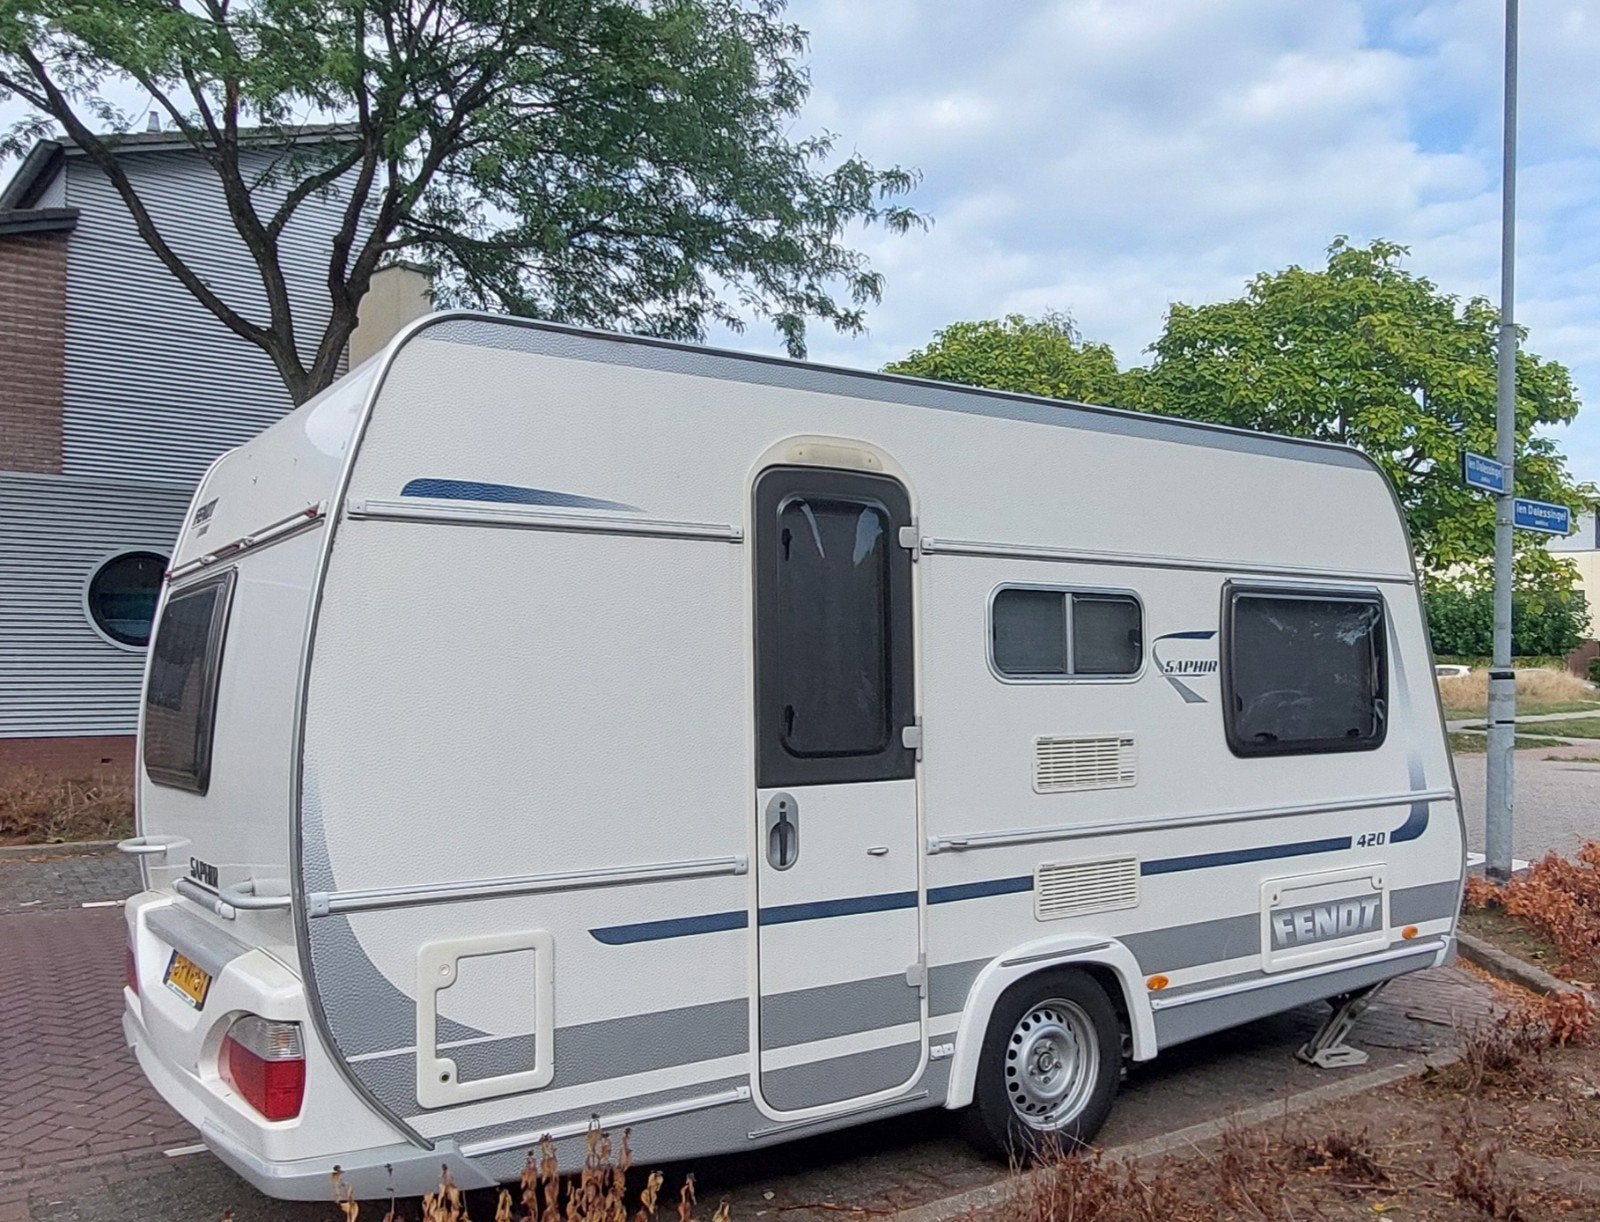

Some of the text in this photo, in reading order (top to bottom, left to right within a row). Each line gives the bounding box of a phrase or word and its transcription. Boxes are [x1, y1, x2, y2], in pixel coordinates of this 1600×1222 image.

[1164, 660, 1218, 673] SAPHIR
[1356, 832, 1386, 848] 420
[190, 856, 218, 889] SAPHIR
[1272, 898, 1380, 944] FENDT
